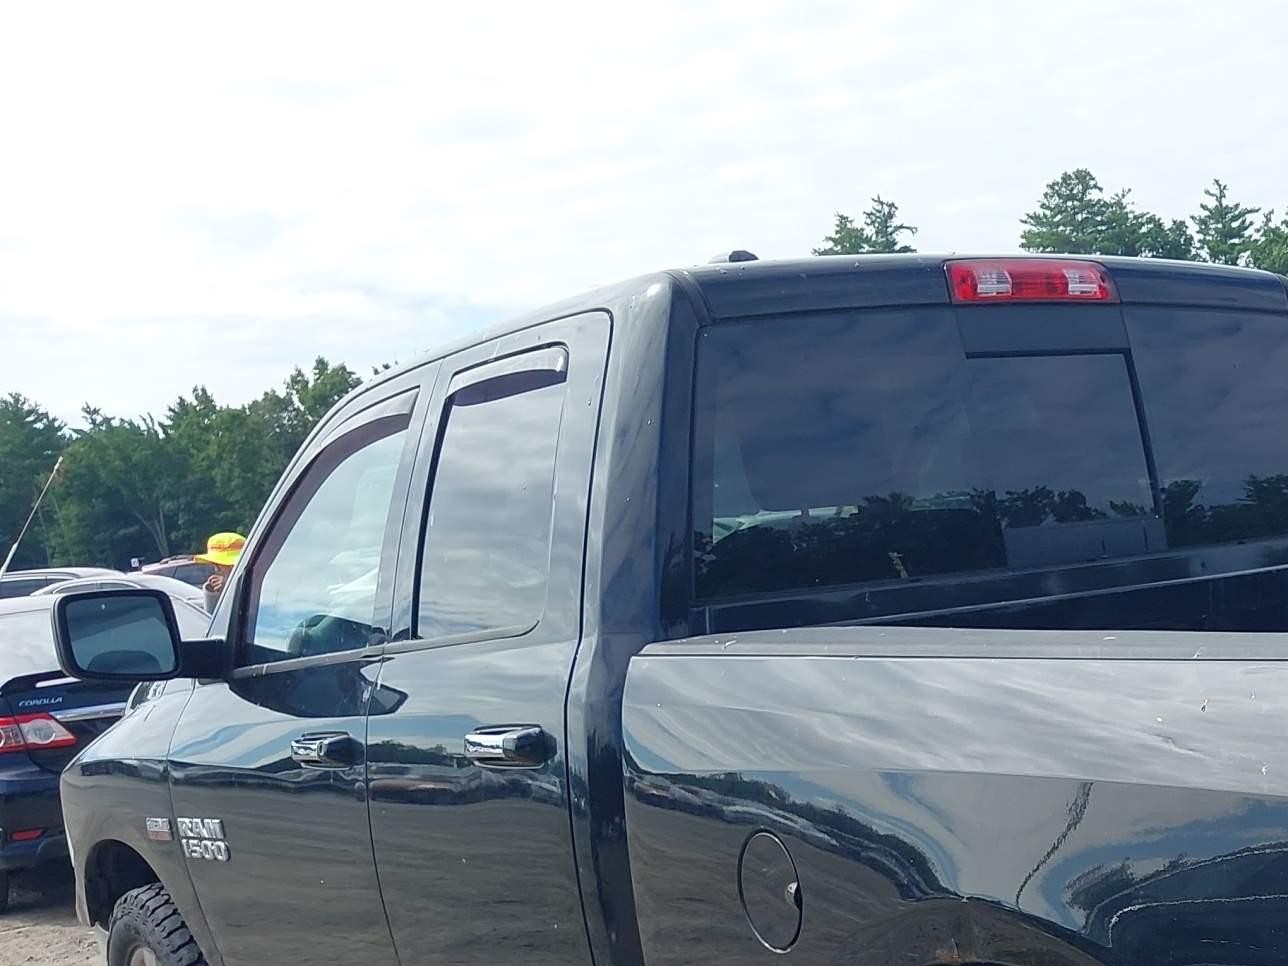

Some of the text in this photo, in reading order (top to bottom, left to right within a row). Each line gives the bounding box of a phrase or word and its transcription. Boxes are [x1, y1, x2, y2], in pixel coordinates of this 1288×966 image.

[18, 696, 63, 707] COROLLA
[177, 817, 226, 839] RAM
[181, 839, 230, 861] 1500
